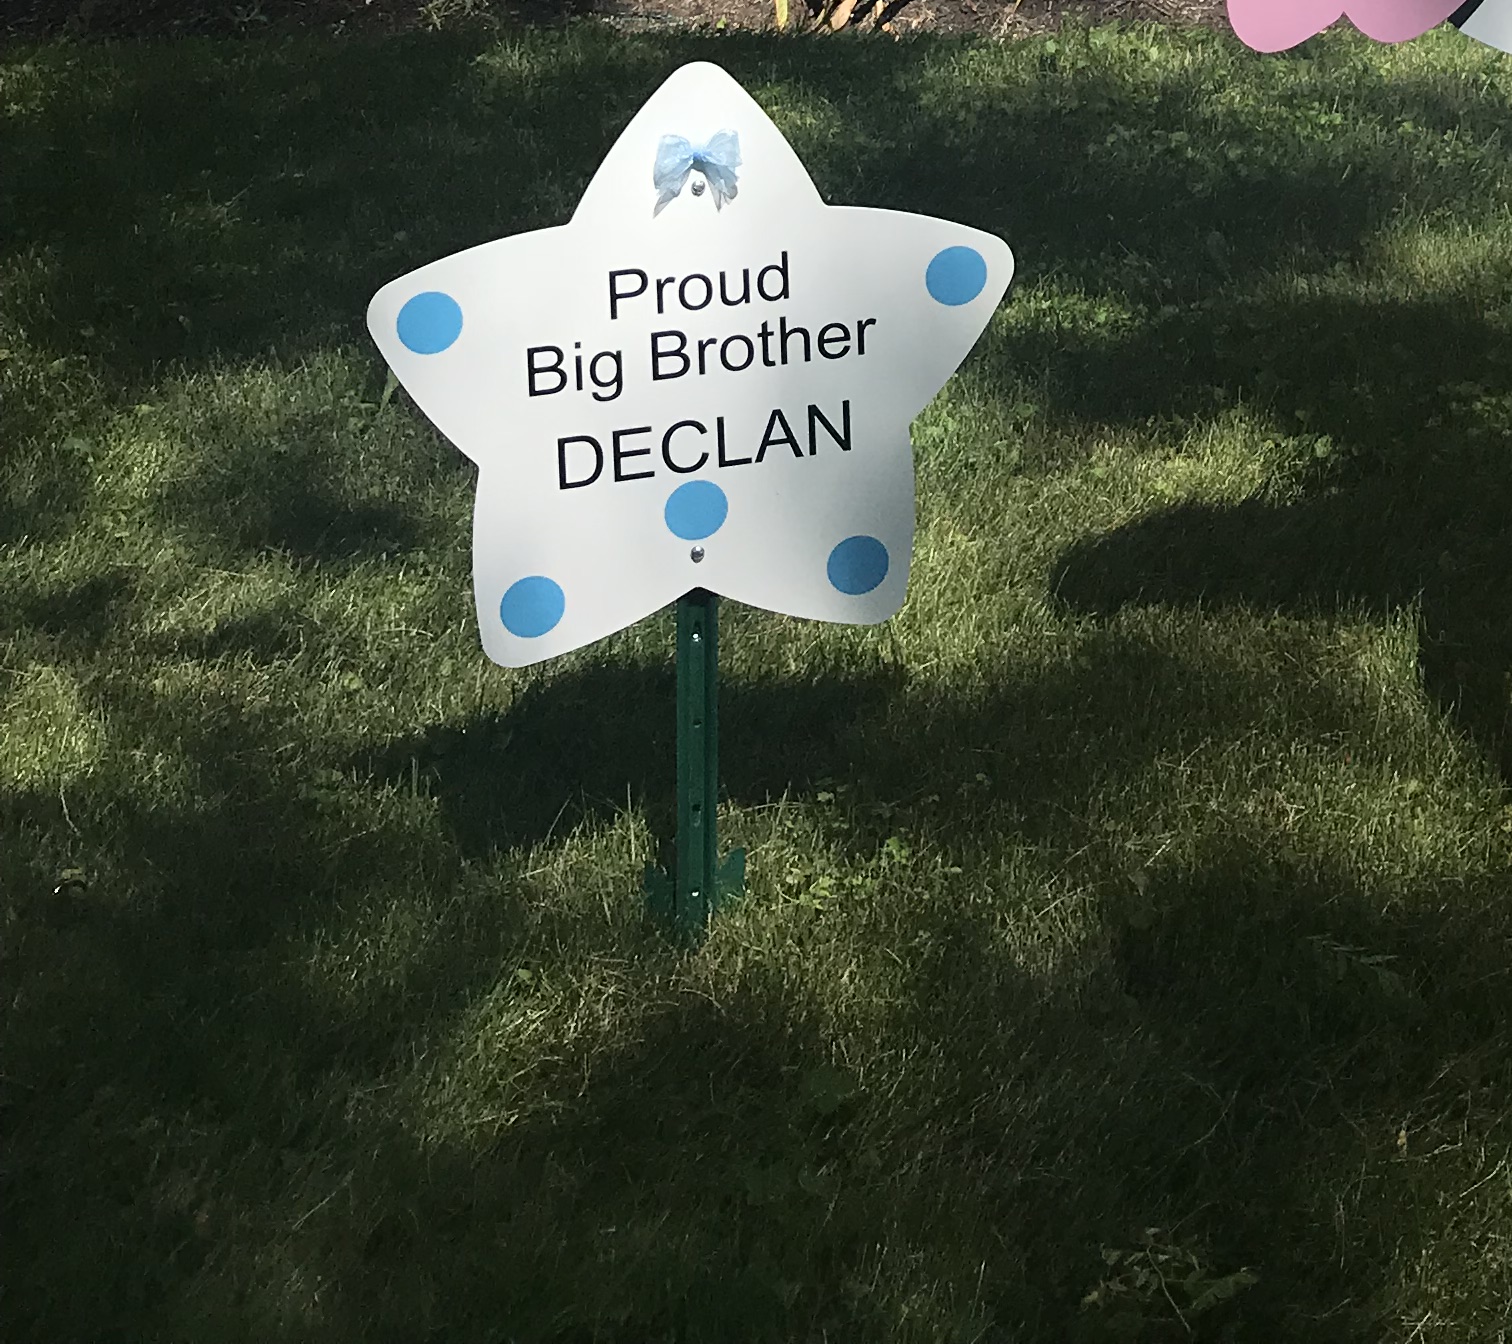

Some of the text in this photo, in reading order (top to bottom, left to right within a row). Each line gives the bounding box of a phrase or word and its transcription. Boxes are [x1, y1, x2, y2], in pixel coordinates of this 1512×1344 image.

[608, 250, 791, 320] Proud
[526, 316, 878, 402] Big Brother
[556, 399, 853, 491] DECLAN
